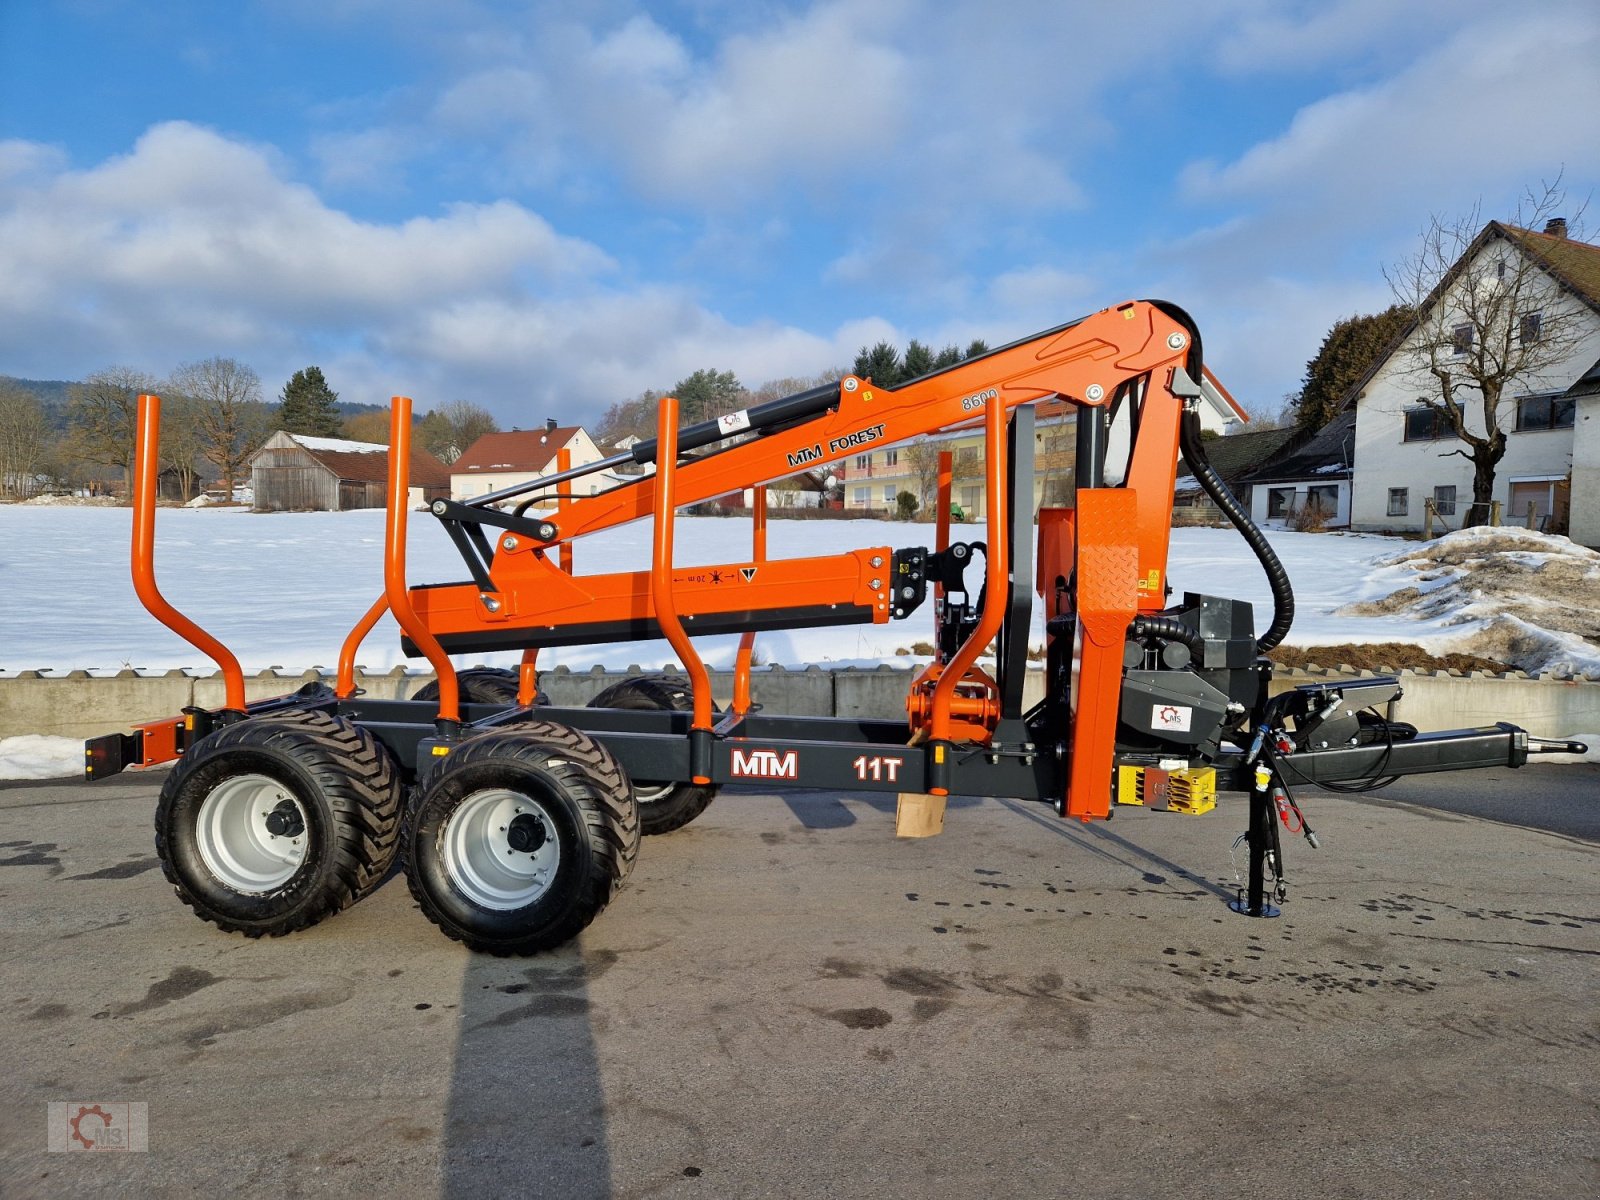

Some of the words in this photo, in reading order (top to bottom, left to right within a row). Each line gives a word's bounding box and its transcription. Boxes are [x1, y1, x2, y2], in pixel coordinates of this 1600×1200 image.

[786, 443, 824, 467] MTM
[829, 423, 886, 453] FOREST
[731, 748, 798, 780] MTM
[852, 754, 903, 782] 11T
